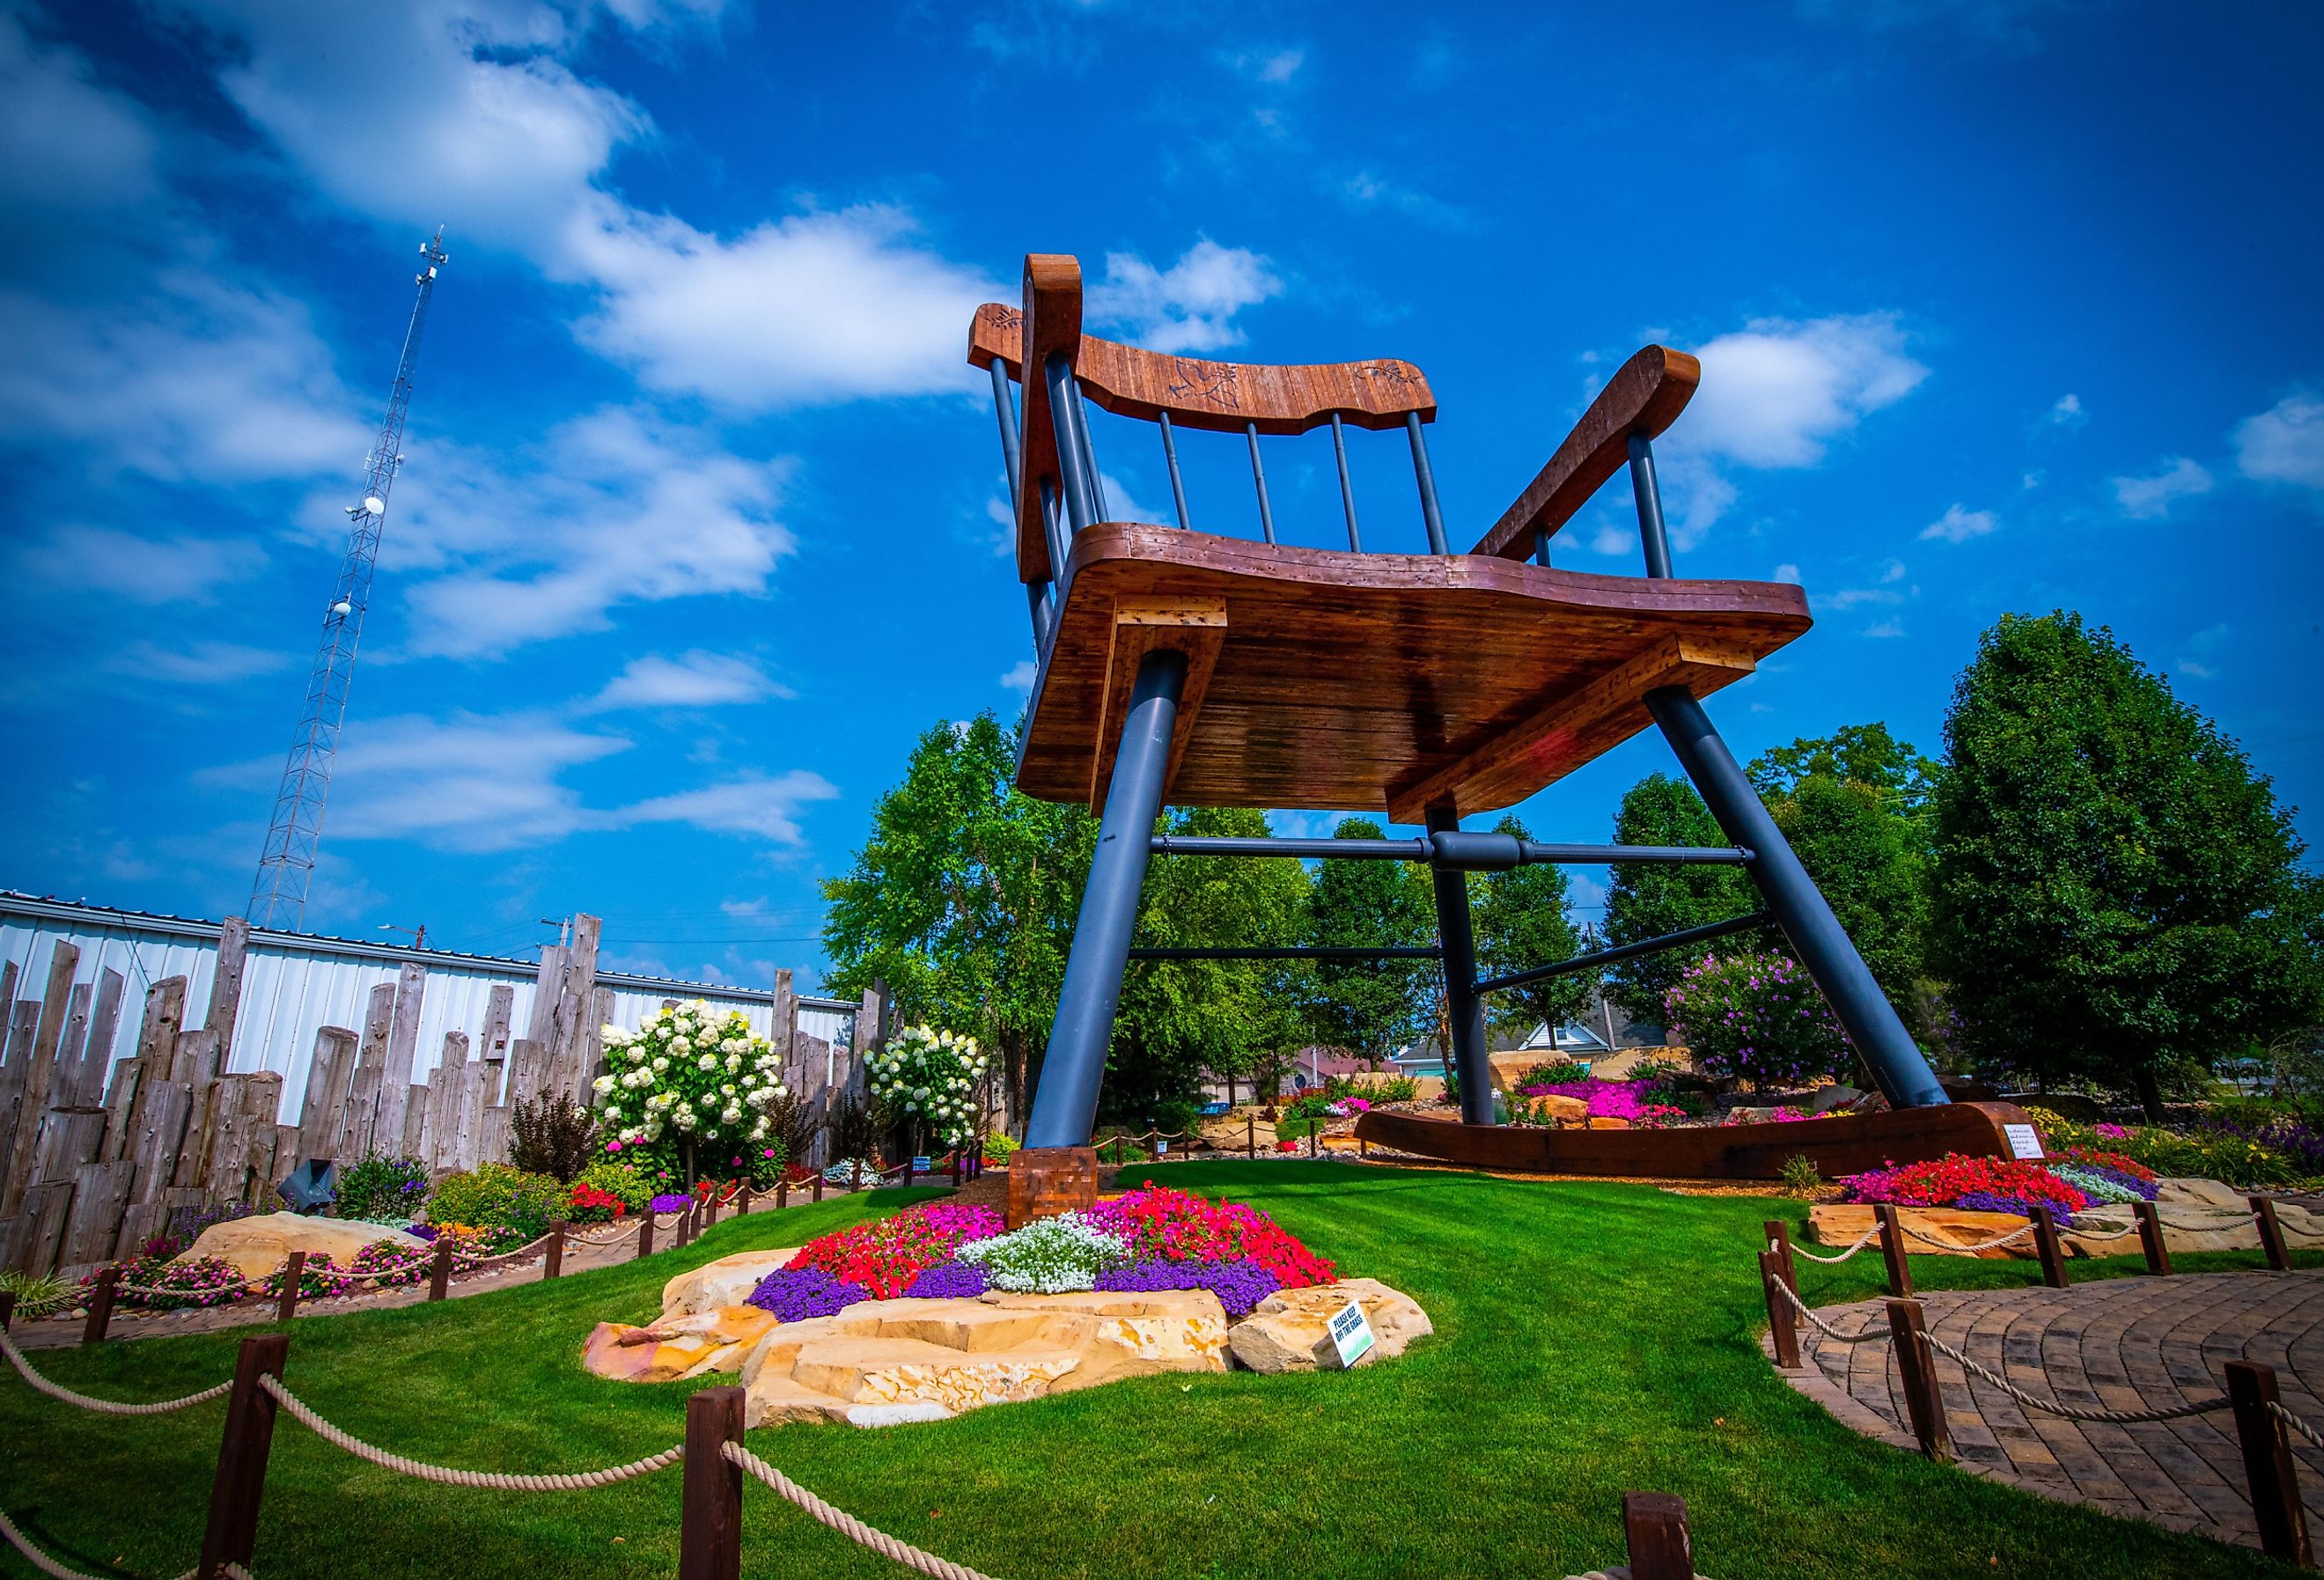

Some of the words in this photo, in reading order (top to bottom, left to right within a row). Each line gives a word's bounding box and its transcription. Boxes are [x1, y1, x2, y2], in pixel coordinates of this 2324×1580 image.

[1333, 1312, 1350, 1330] PLEASE
[1346, 1305, 1357, 1319] KEEP
[1335, 1329, 1345, 1342] OFF
[1342, 1323, 1352, 1336] THE
[1350, 1313, 1364, 1330] GRASS
